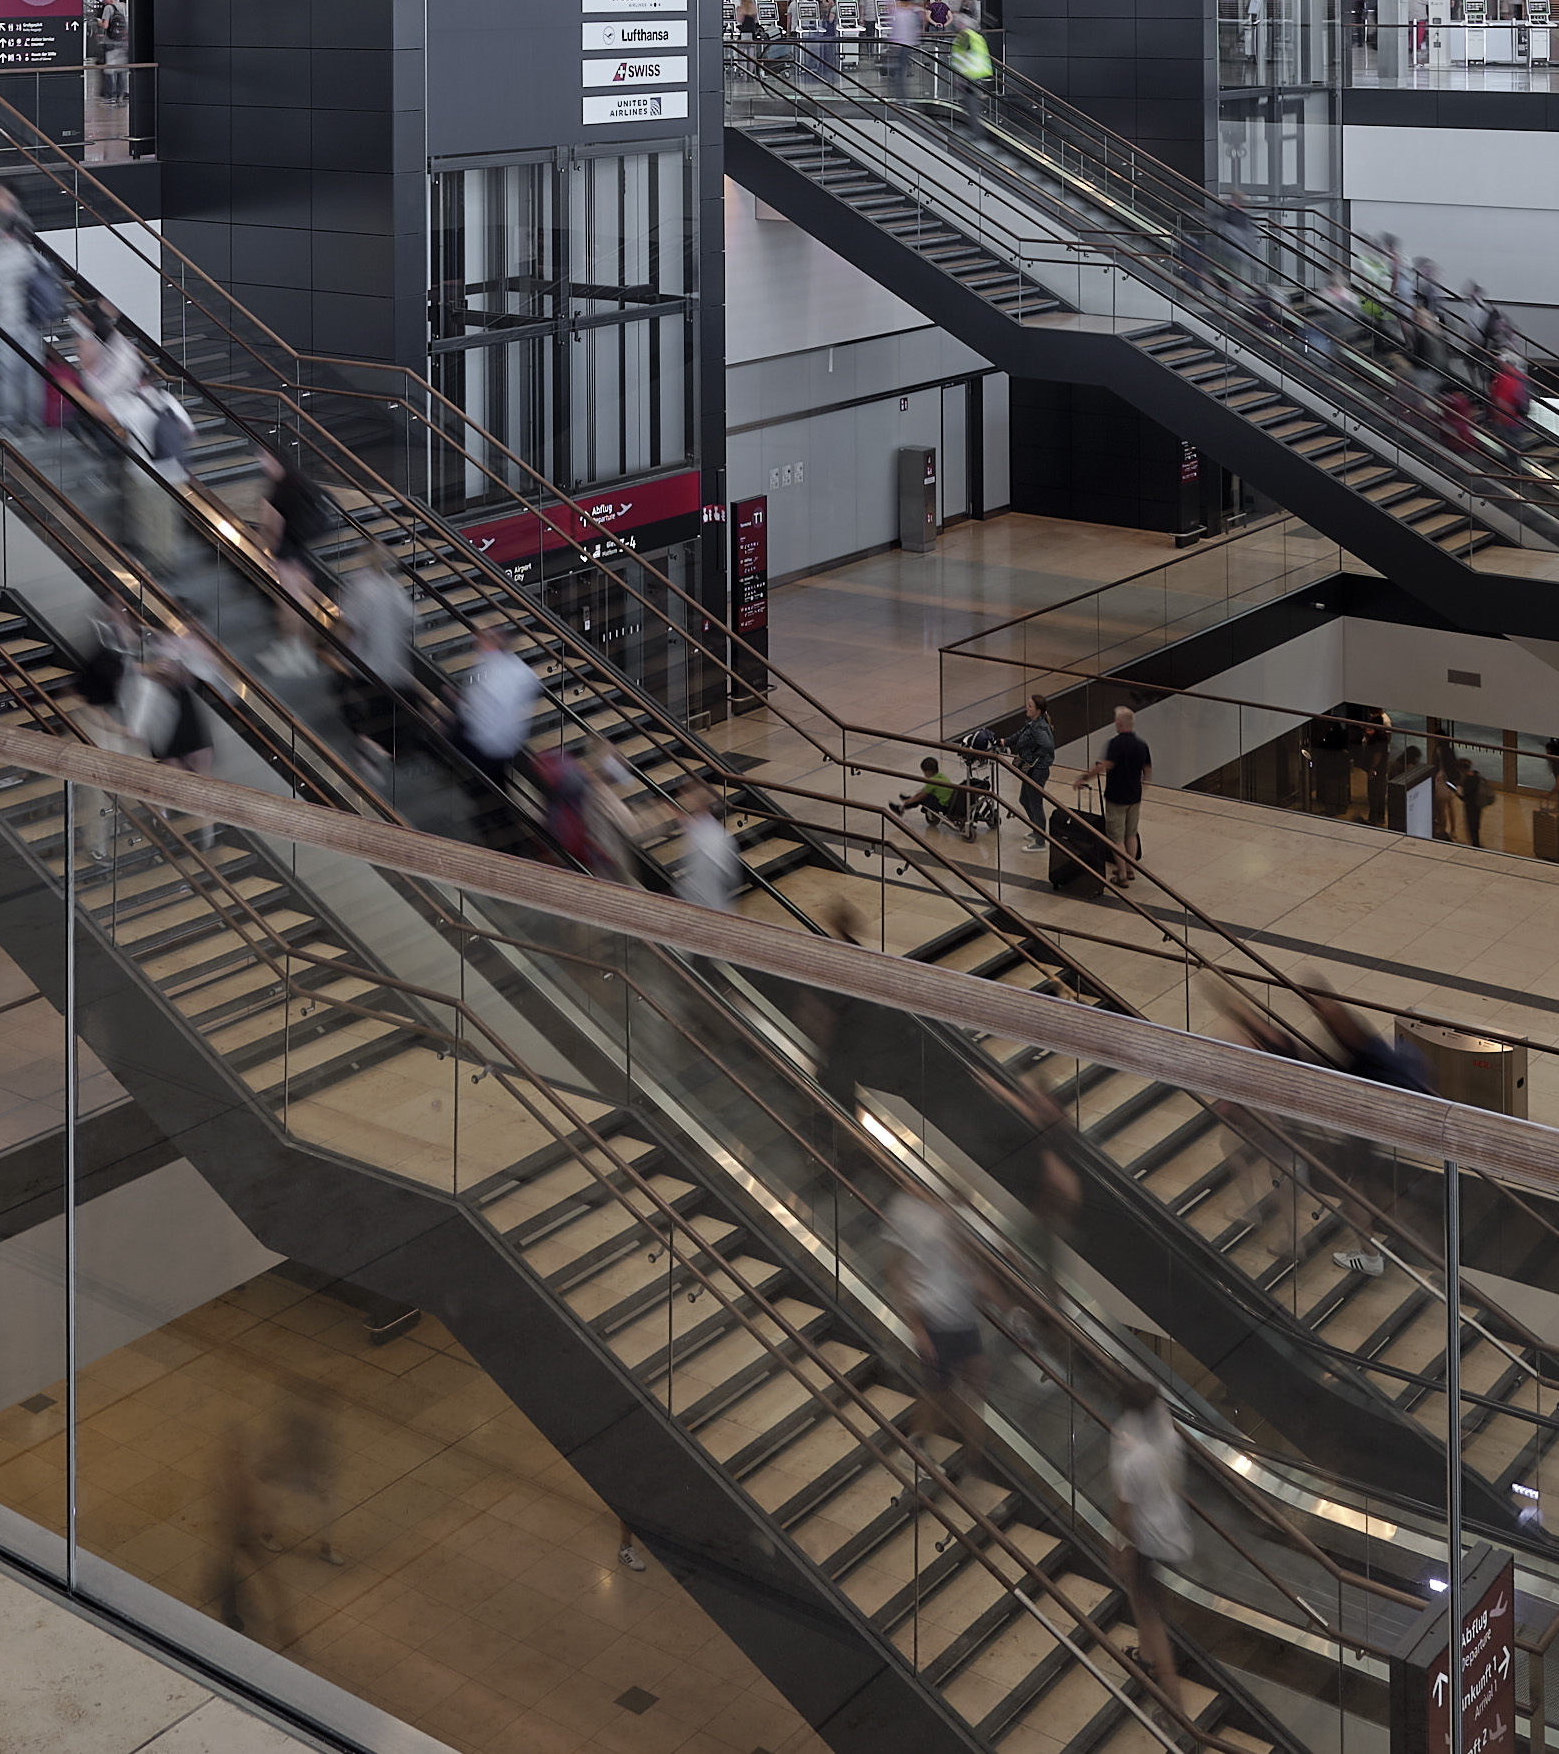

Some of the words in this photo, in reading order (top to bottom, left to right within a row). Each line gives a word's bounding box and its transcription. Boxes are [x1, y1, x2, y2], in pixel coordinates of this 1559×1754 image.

[621, 28, 669, 42] Lufthansa
[628, 64, 661, 78] SWISS
[617, 99, 648, 108] UNITED
[609, 108, 648, 117] AIRLINES
[591, 504, 613, 517] Abflug
[753, 511, 763, 525] T1
[514, 563, 532, 574] Airport
[514, 573, 525, 582] City
[1462, 1662, 1492, 1712] nkunft
[1492, 1654, 1497, 1672] 1
[1474, 1684, 1494, 1721] Arrival
[1482, 1726, 1488, 1747] 2
